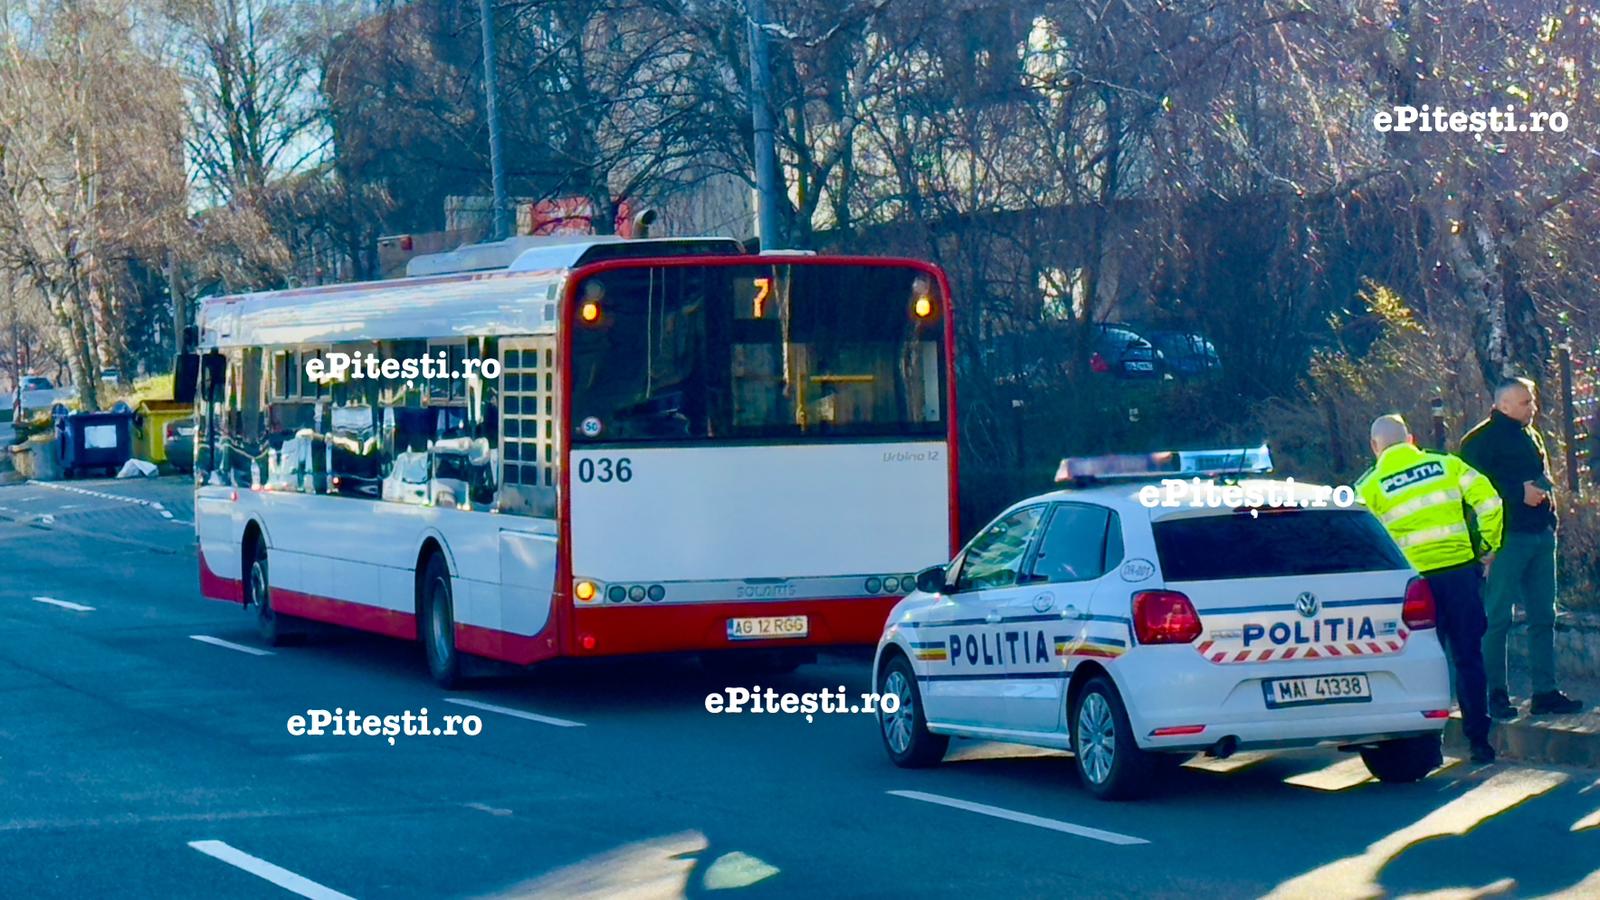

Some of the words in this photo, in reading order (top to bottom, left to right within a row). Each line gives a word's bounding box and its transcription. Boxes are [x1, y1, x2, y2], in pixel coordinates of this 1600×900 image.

[753, 278, 769, 318] 7
[585, 421, 598, 431] 50
[883, 451, 925, 462] Urbino
[928, 450, 939, 461] 12
[578, 457, 633, 483] 036
[736, 585, 797, 598] SOLARIS
[735, 620, 753, 634] AG
[758, 619, 771, 633] 12
[774, 617, 804, 632] RGG
[1243, 617, 1376, 647] POLITIA
[949, 630, 1049, 666] POLITIA
[1279, 681, 1307, 700] MAI
[1315, 677, 1362, 695] 41338
